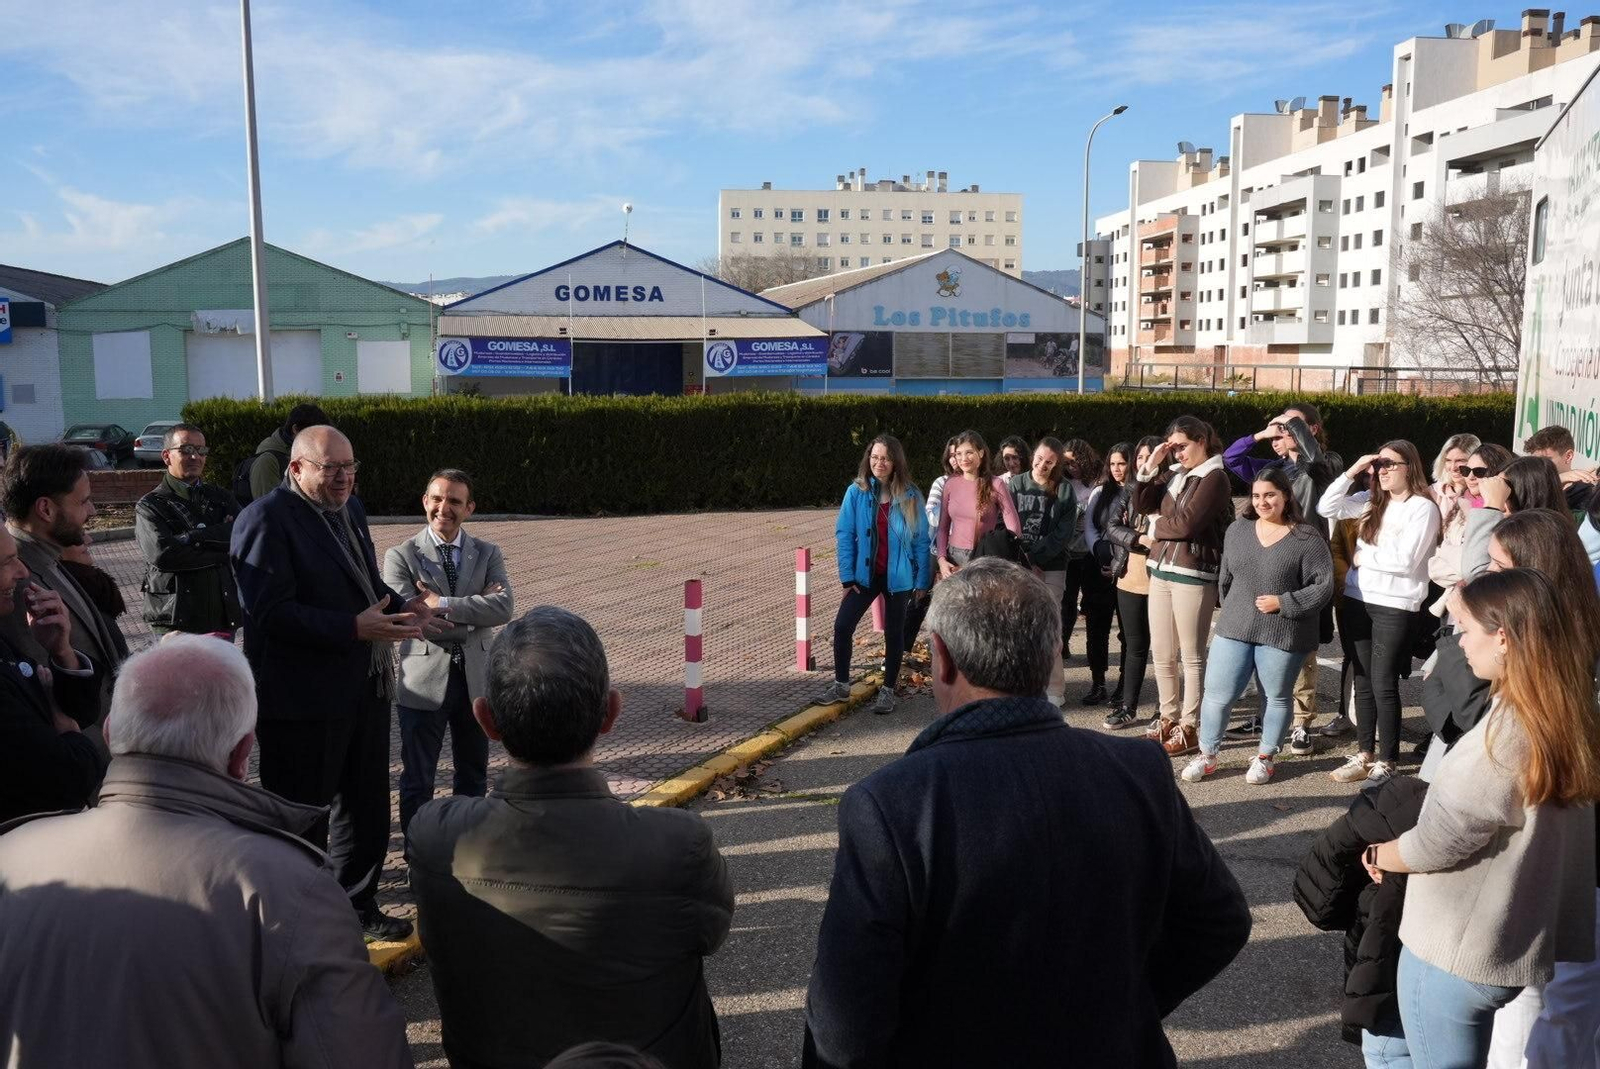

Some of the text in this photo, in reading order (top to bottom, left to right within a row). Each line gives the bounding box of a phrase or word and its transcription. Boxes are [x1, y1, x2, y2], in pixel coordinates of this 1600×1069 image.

[554, 284, 665, 302] GOMESA
[1559, 254, 1594, 328] Junta
[873, 304, 1031, 328] Los Pitufos
[487, 341, 540, 352] GOMESA
[751, 341, 799, 352] GOMESA
